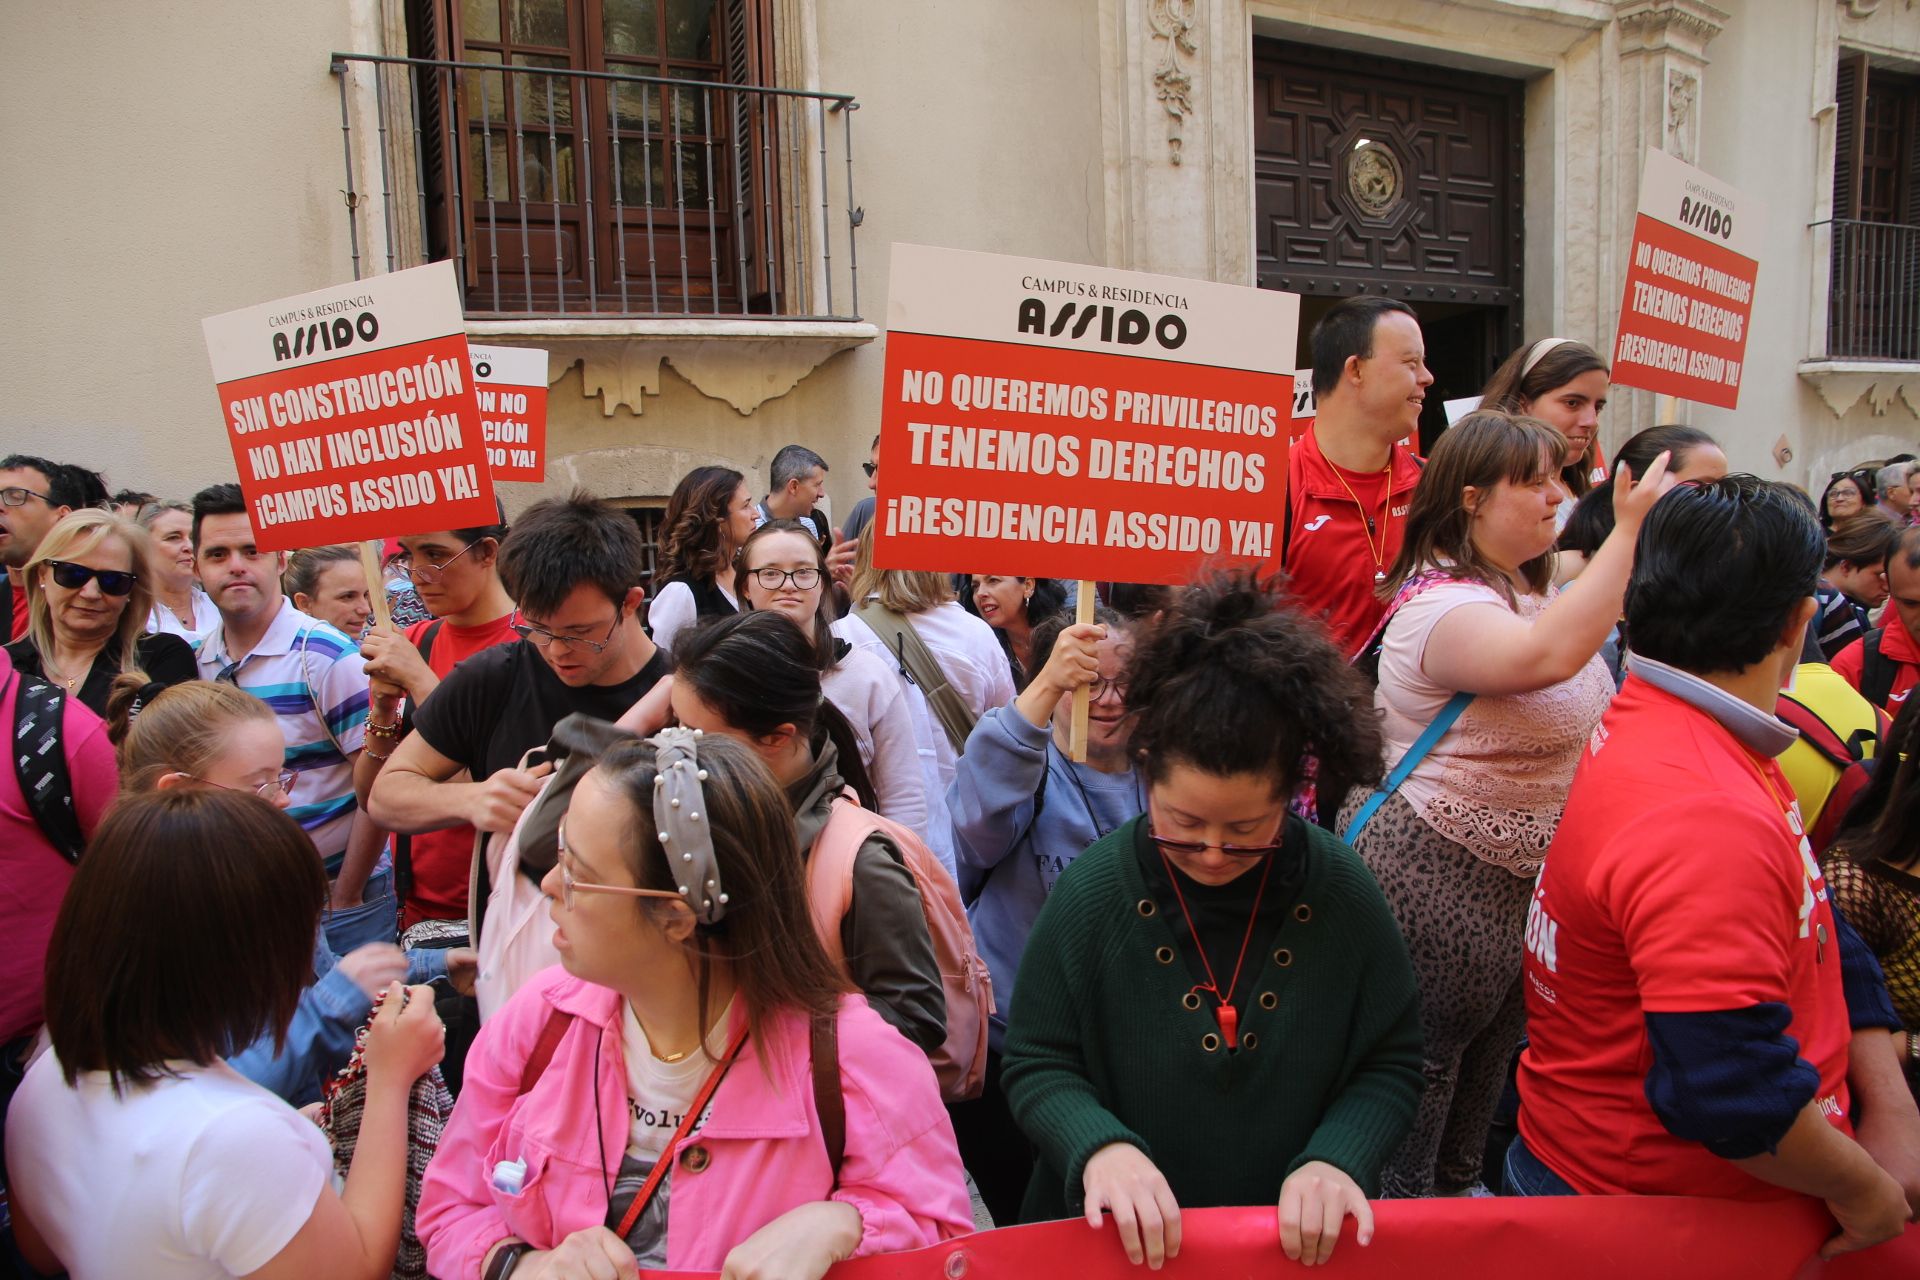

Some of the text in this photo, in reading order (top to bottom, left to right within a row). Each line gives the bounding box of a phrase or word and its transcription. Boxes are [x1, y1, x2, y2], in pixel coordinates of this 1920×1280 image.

[1679, 196, 1732, 240] ASSIDO
[1022, 276, 1189, 310] CAMPUS & RESIDENCIA
[1635, 241, 1751, 305] NO QUEREMOS PRIVILEGIOS
[268, 293, 375, 328] CAMPUS & RESIDENCIA
[272, 311, 379, 362] ASSIDO
[1018, 298, 1188, 350] ASSIDO
[1632, 281, 1743, 342] TENEMOS DERECHOS
[1617, 333, 1741, 387] ¡RESIDENCIA ASSIDO YA!
[230, 395, 269, 435] SIN
[269, 354, 464, 428] CONSTRUCCIÓN
[500, 392, 527, 415] NO
[902, 369, 944, 405] NO
[951, 373, 1108, 421] QUEREMOS
[1114, 389, 1277, 438] PRIVILEGIOS
[248, 409, 463, 481] NO HAY INCLUSIÓN
[510, 449, 536, 468] YA!
[907, 422, 1266, 493] TENEMOS DERECHOS
[255, 463, 480, 530] ¡CAMPUS ASSIDO YA!
[886, 495, 1274, 558] ¡RESIDENCIA ASSIDO YA!
